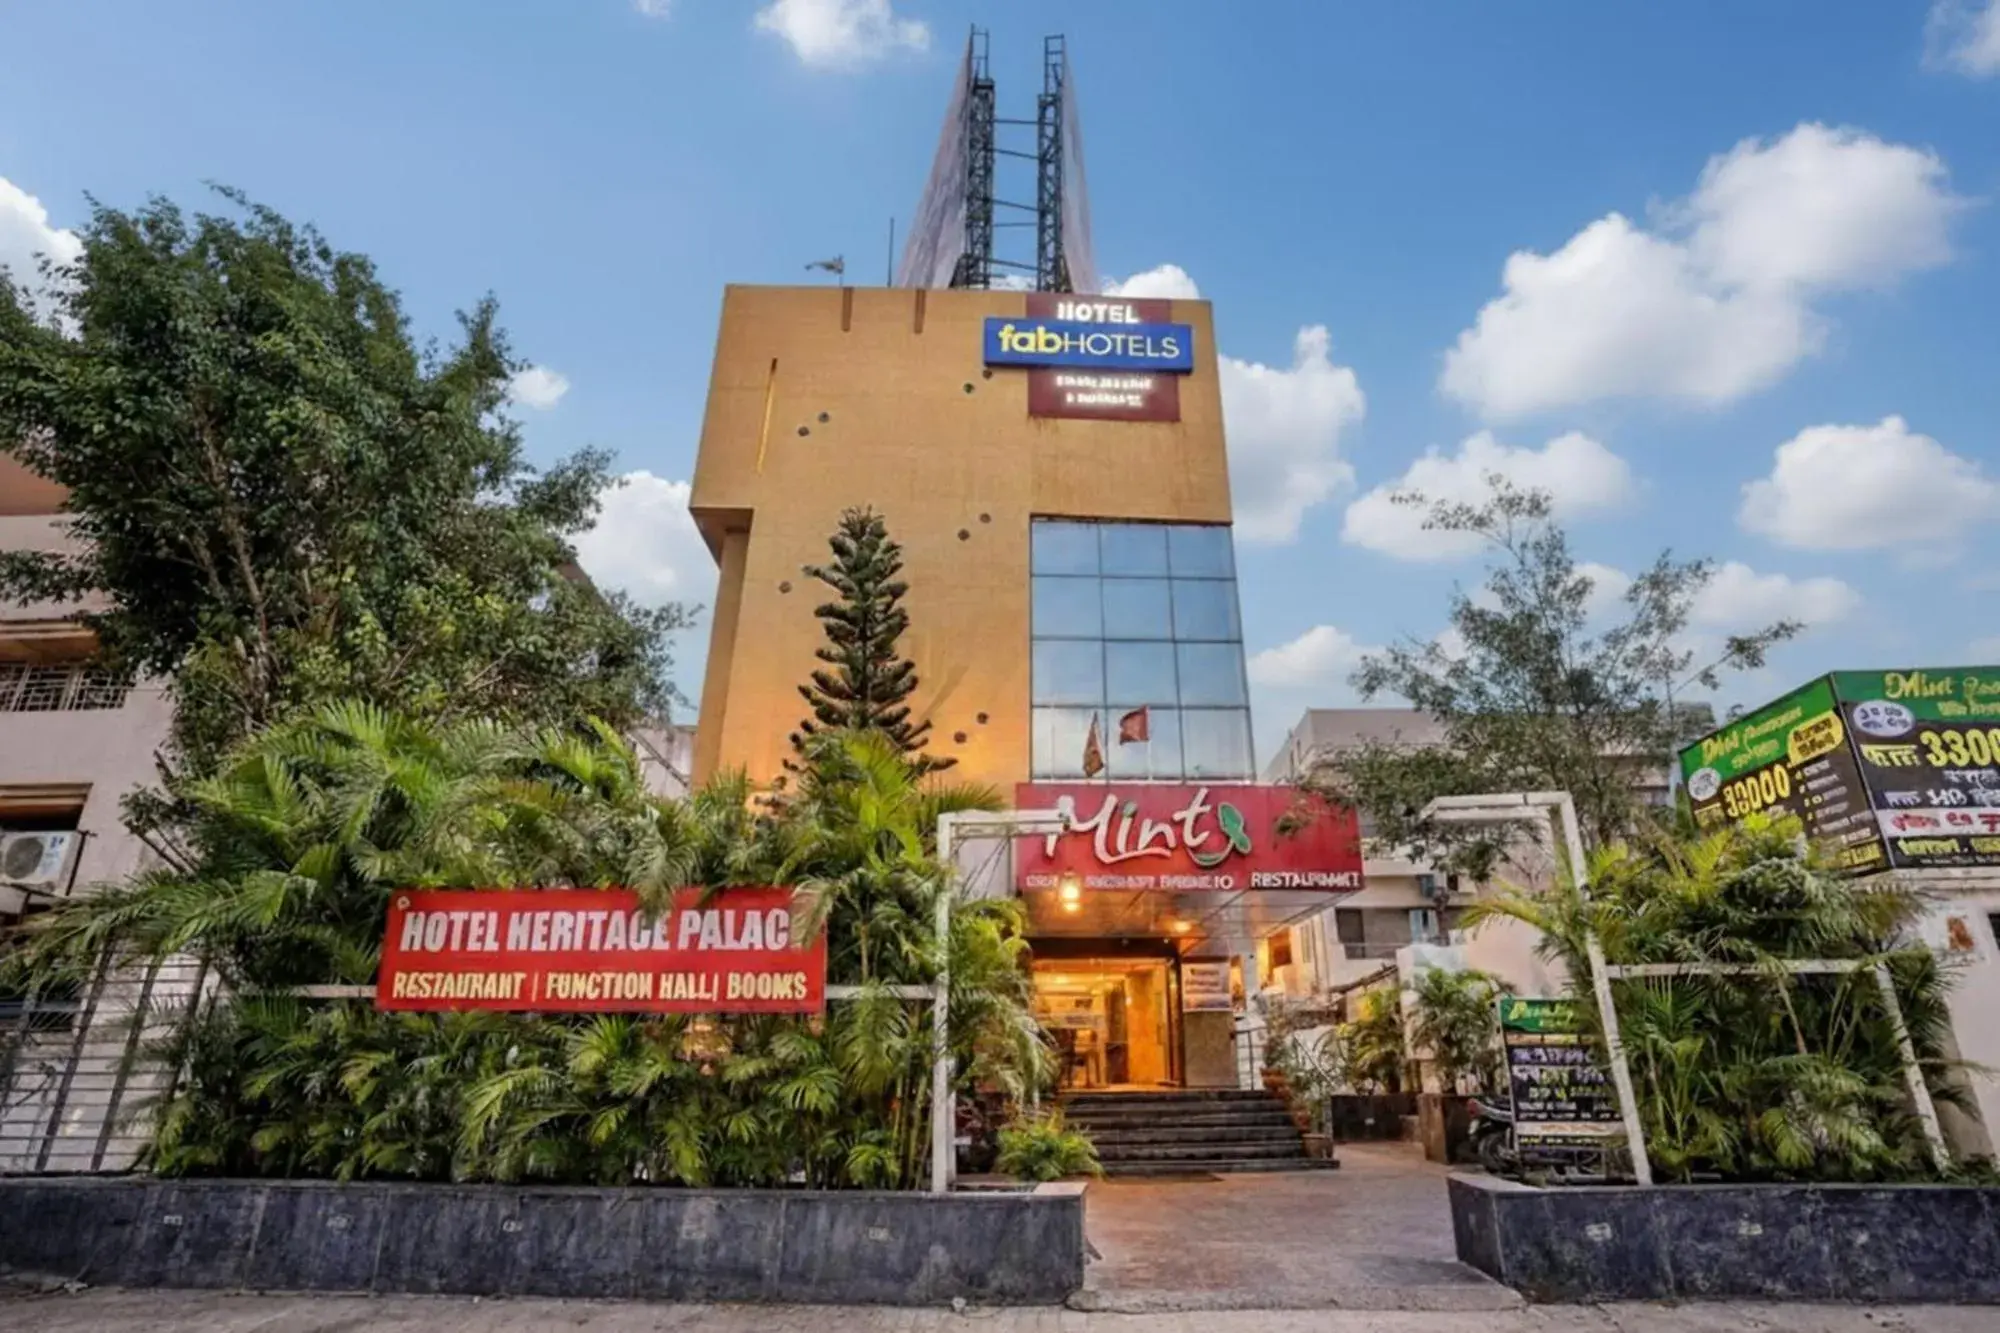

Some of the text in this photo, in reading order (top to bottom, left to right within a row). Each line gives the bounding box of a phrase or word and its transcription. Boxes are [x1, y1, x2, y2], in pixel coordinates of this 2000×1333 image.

[1057, 302, 1141, 324] HOTEL
[998, 324, 1180, 358] fabHOTELS
[1045, 786, 1214, 865] Mint
[400, 911, 499, 952] HOTEL
[506, 909, 671, 952] HERITAGE
[392, 971, 527, 999] RESTAURANT
[545, 972, 653, 1000] FUNCTION
[658, 972, 713, 1000] HALL
